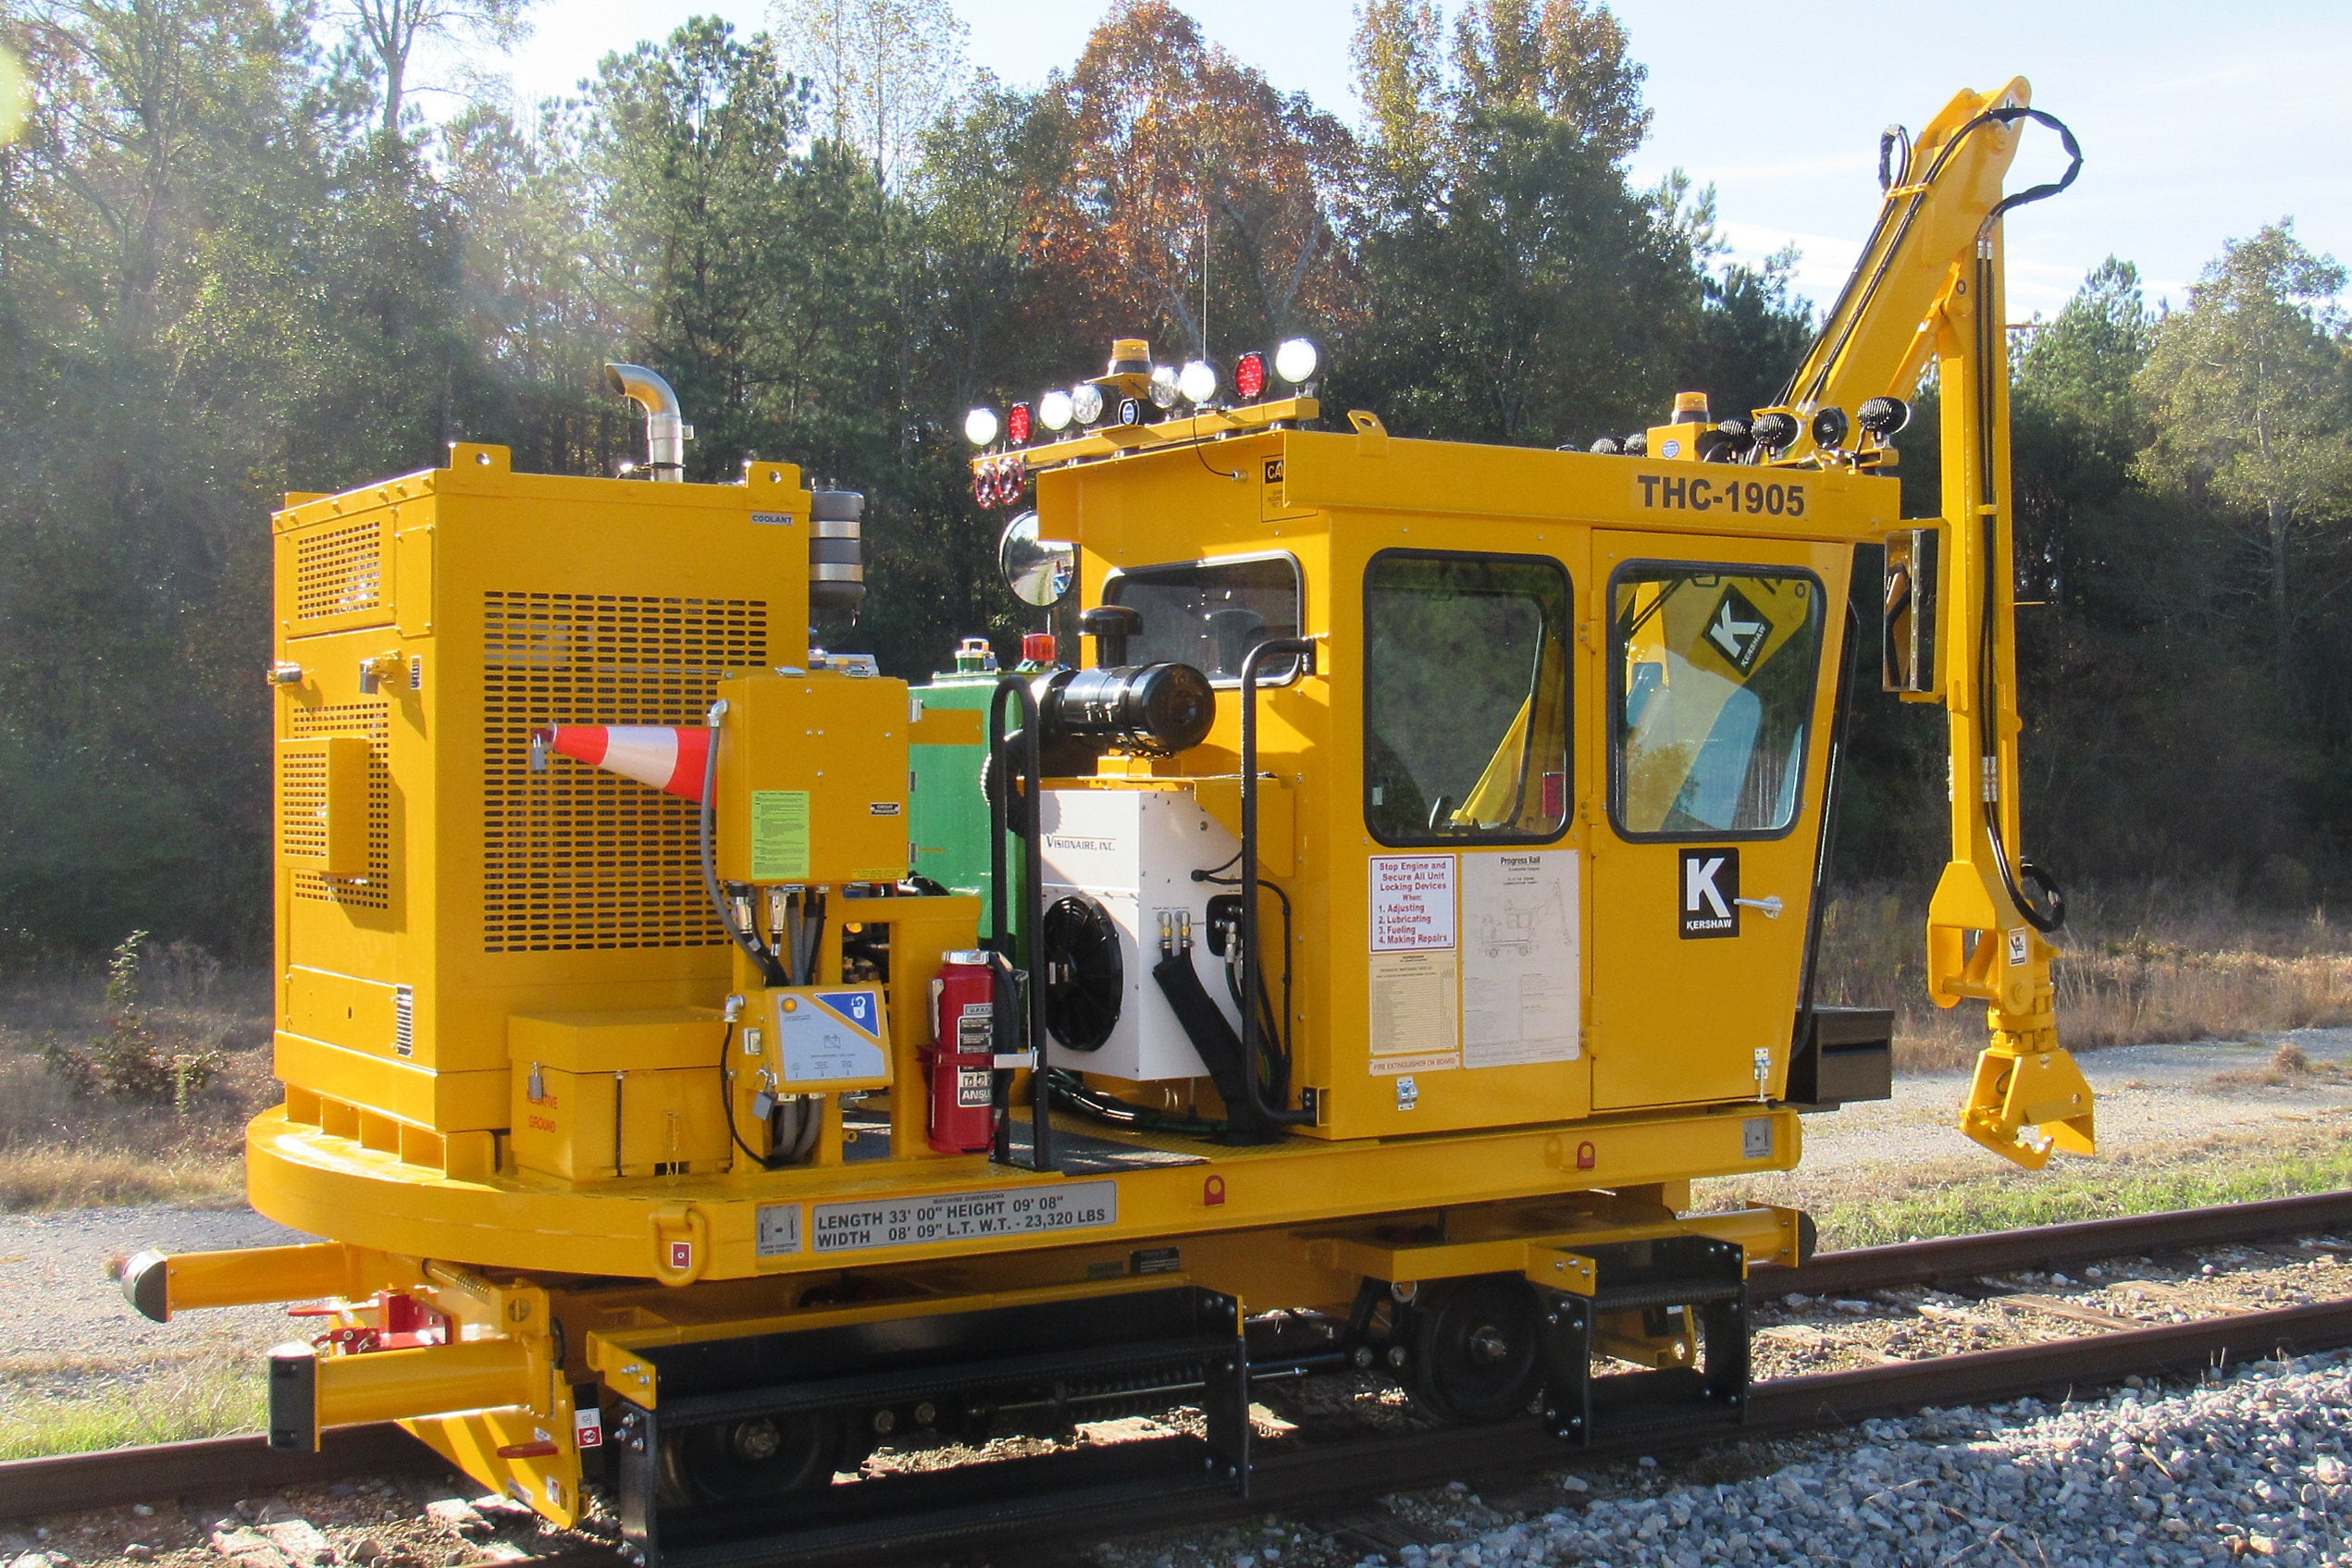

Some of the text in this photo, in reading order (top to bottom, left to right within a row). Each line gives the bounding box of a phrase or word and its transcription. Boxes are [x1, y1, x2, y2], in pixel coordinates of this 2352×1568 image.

[1637, 475, 1804, 517] THC-1905
[752, 514, 792, 525] COOLANT
[1710, 599, 1761, 659] K
[1739, 623, 1766, 667] KERSHAW
[1099, 841, 1116, 851] INC.
[1379, 861, 1446, 872] Stop Engine and
[1500, 856, 1541, 866] Progress Rail
[1382, 871, 1444, 882] Secure All Unit
[1380, 882, 1447, 892] Locking Devices
[1686, 857, 1731, 918] K
[1379, 903, 1425, 914] 1. Adjusting
[1378, 914, 1431, 924] 2. Lubricating
[1378, 925, 1416, 935] 3. Fueling
[1686, 919, 1732, 931] KERSHAW
[1387, 935, 1416, 945] Making
[1417, 933, 1447, 944] Repairs
[1387, 1059, 1426, 1069] EXTINGUISHER
[1436, 1057, 1455, 1066] BOARD
[962, 1089, 992, 1100] ANSU
[529, 1115, 556, 1133] GROUND
[818, 1195, 1063, 1230] LENGTH 33' 00" HEIGHT 09' 08"
[818, 1230, 871, 1247] WIDTH
[888, 1227, 910, 1241] 08'
[917, 1223, 942, 1238] 09"
[947, 1221, 974, 1235] L.T.
[979, 1217, 1011, 1232] W.T.
[1025, 1211, 1072, 1229] 23,320
[1077, 1208, 1106, 1223] LBS
